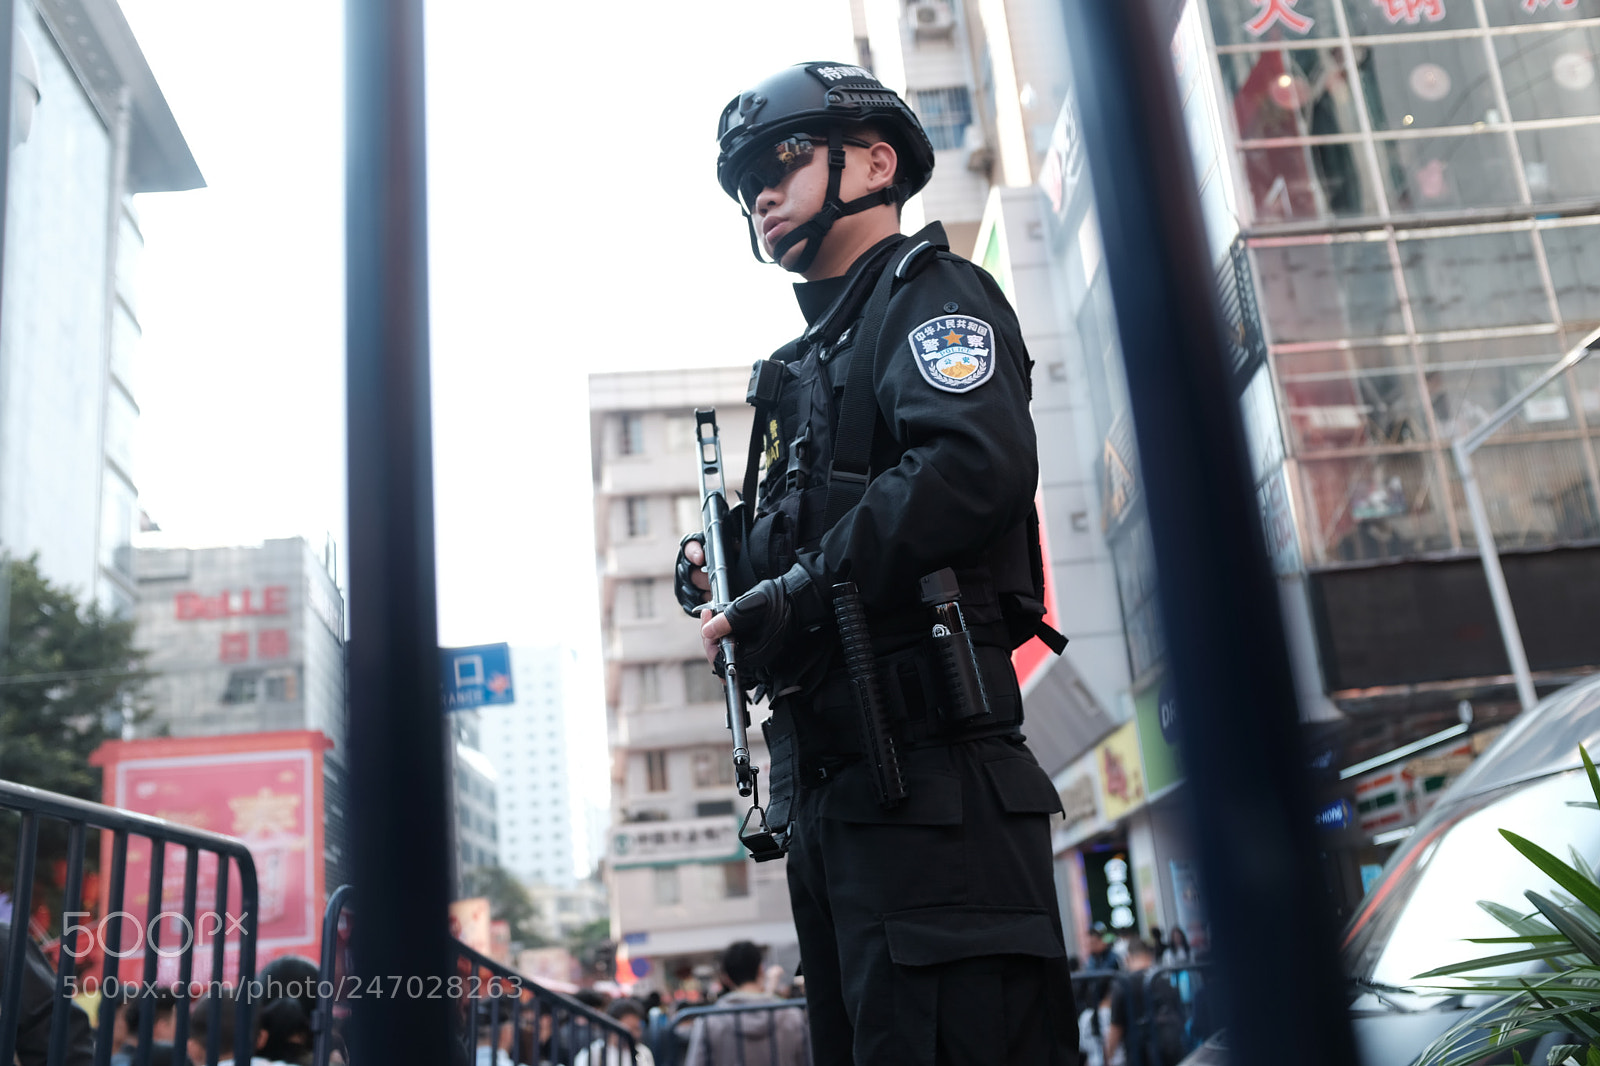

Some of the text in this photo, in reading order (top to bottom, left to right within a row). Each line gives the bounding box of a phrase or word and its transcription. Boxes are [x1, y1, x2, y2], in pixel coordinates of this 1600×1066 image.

[915, 319, 988, 341] 中华人民共和国
[921, 335, 985, 352] 警 察
